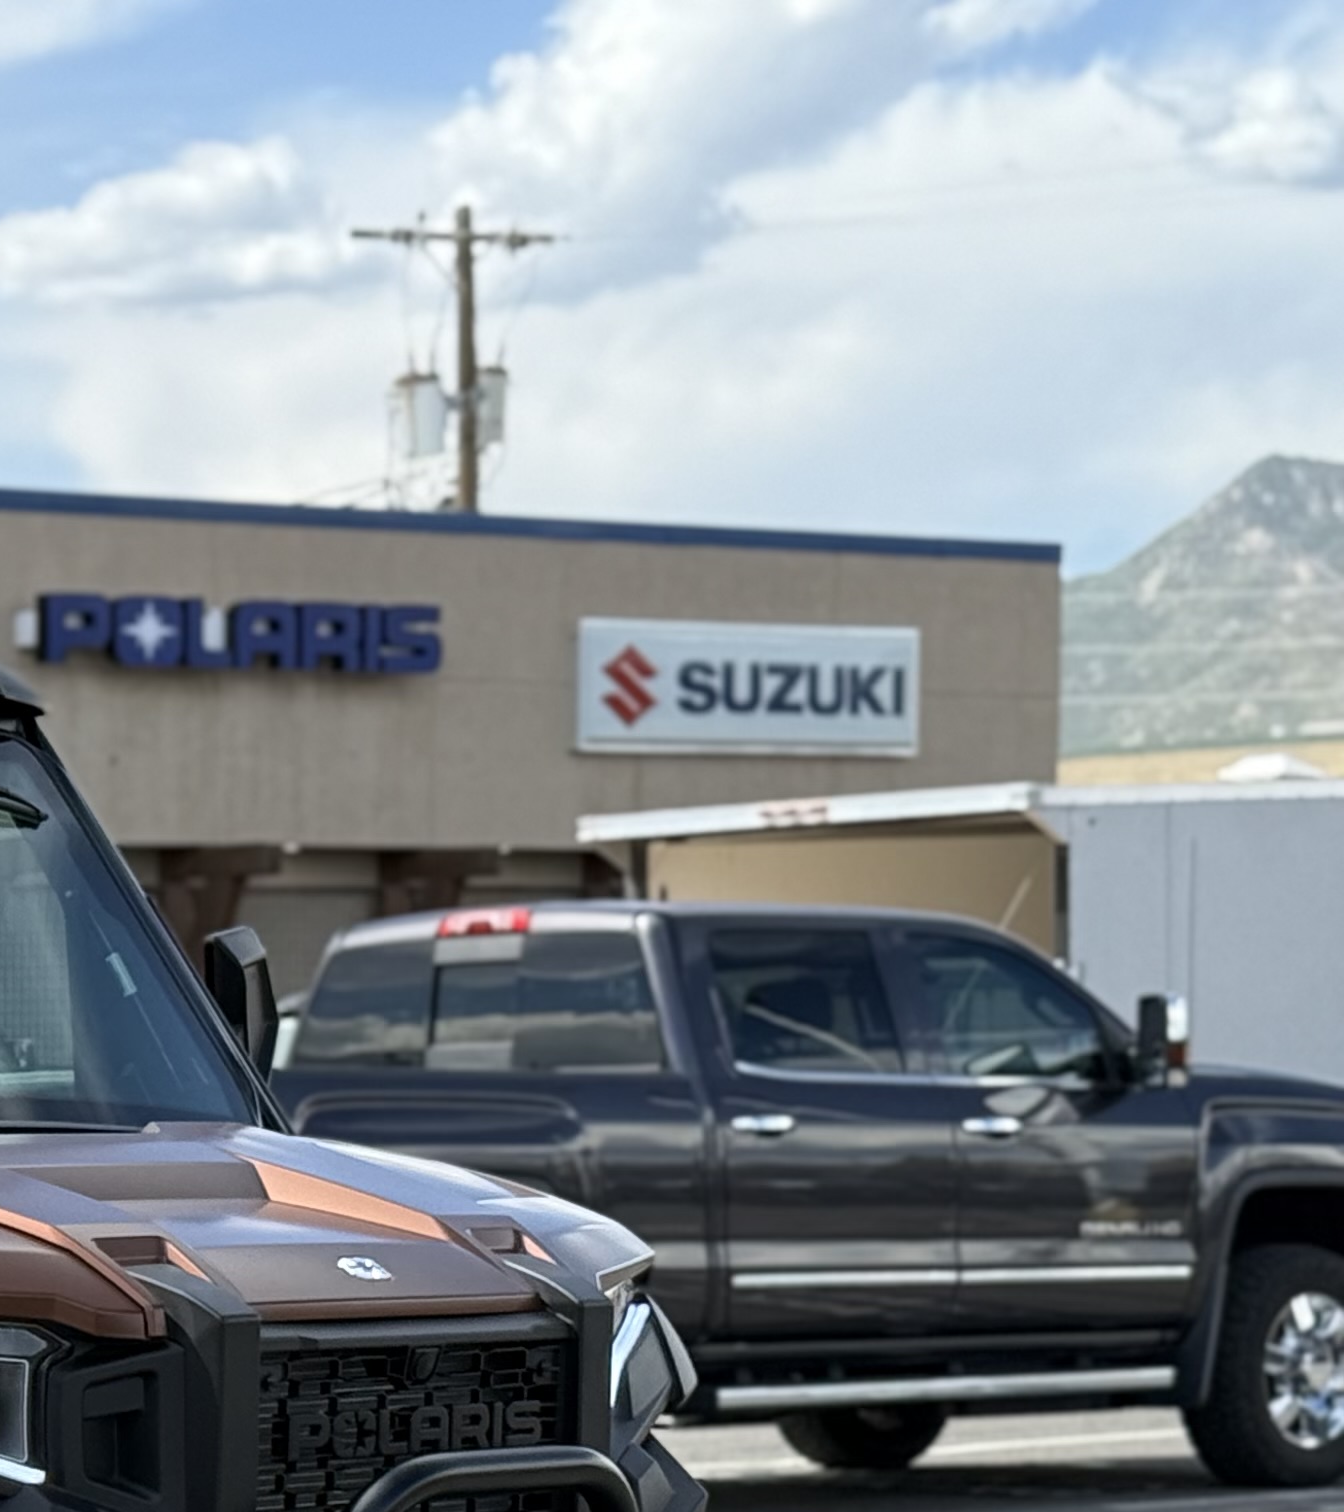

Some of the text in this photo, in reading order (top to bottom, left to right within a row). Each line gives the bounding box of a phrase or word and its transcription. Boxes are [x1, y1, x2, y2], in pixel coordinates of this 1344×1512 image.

[37, 593, 443, 674] POLARIS
[676, 659, 907, 717] SUZUKI
[287, 1400, 543, 1463] POLARIS
